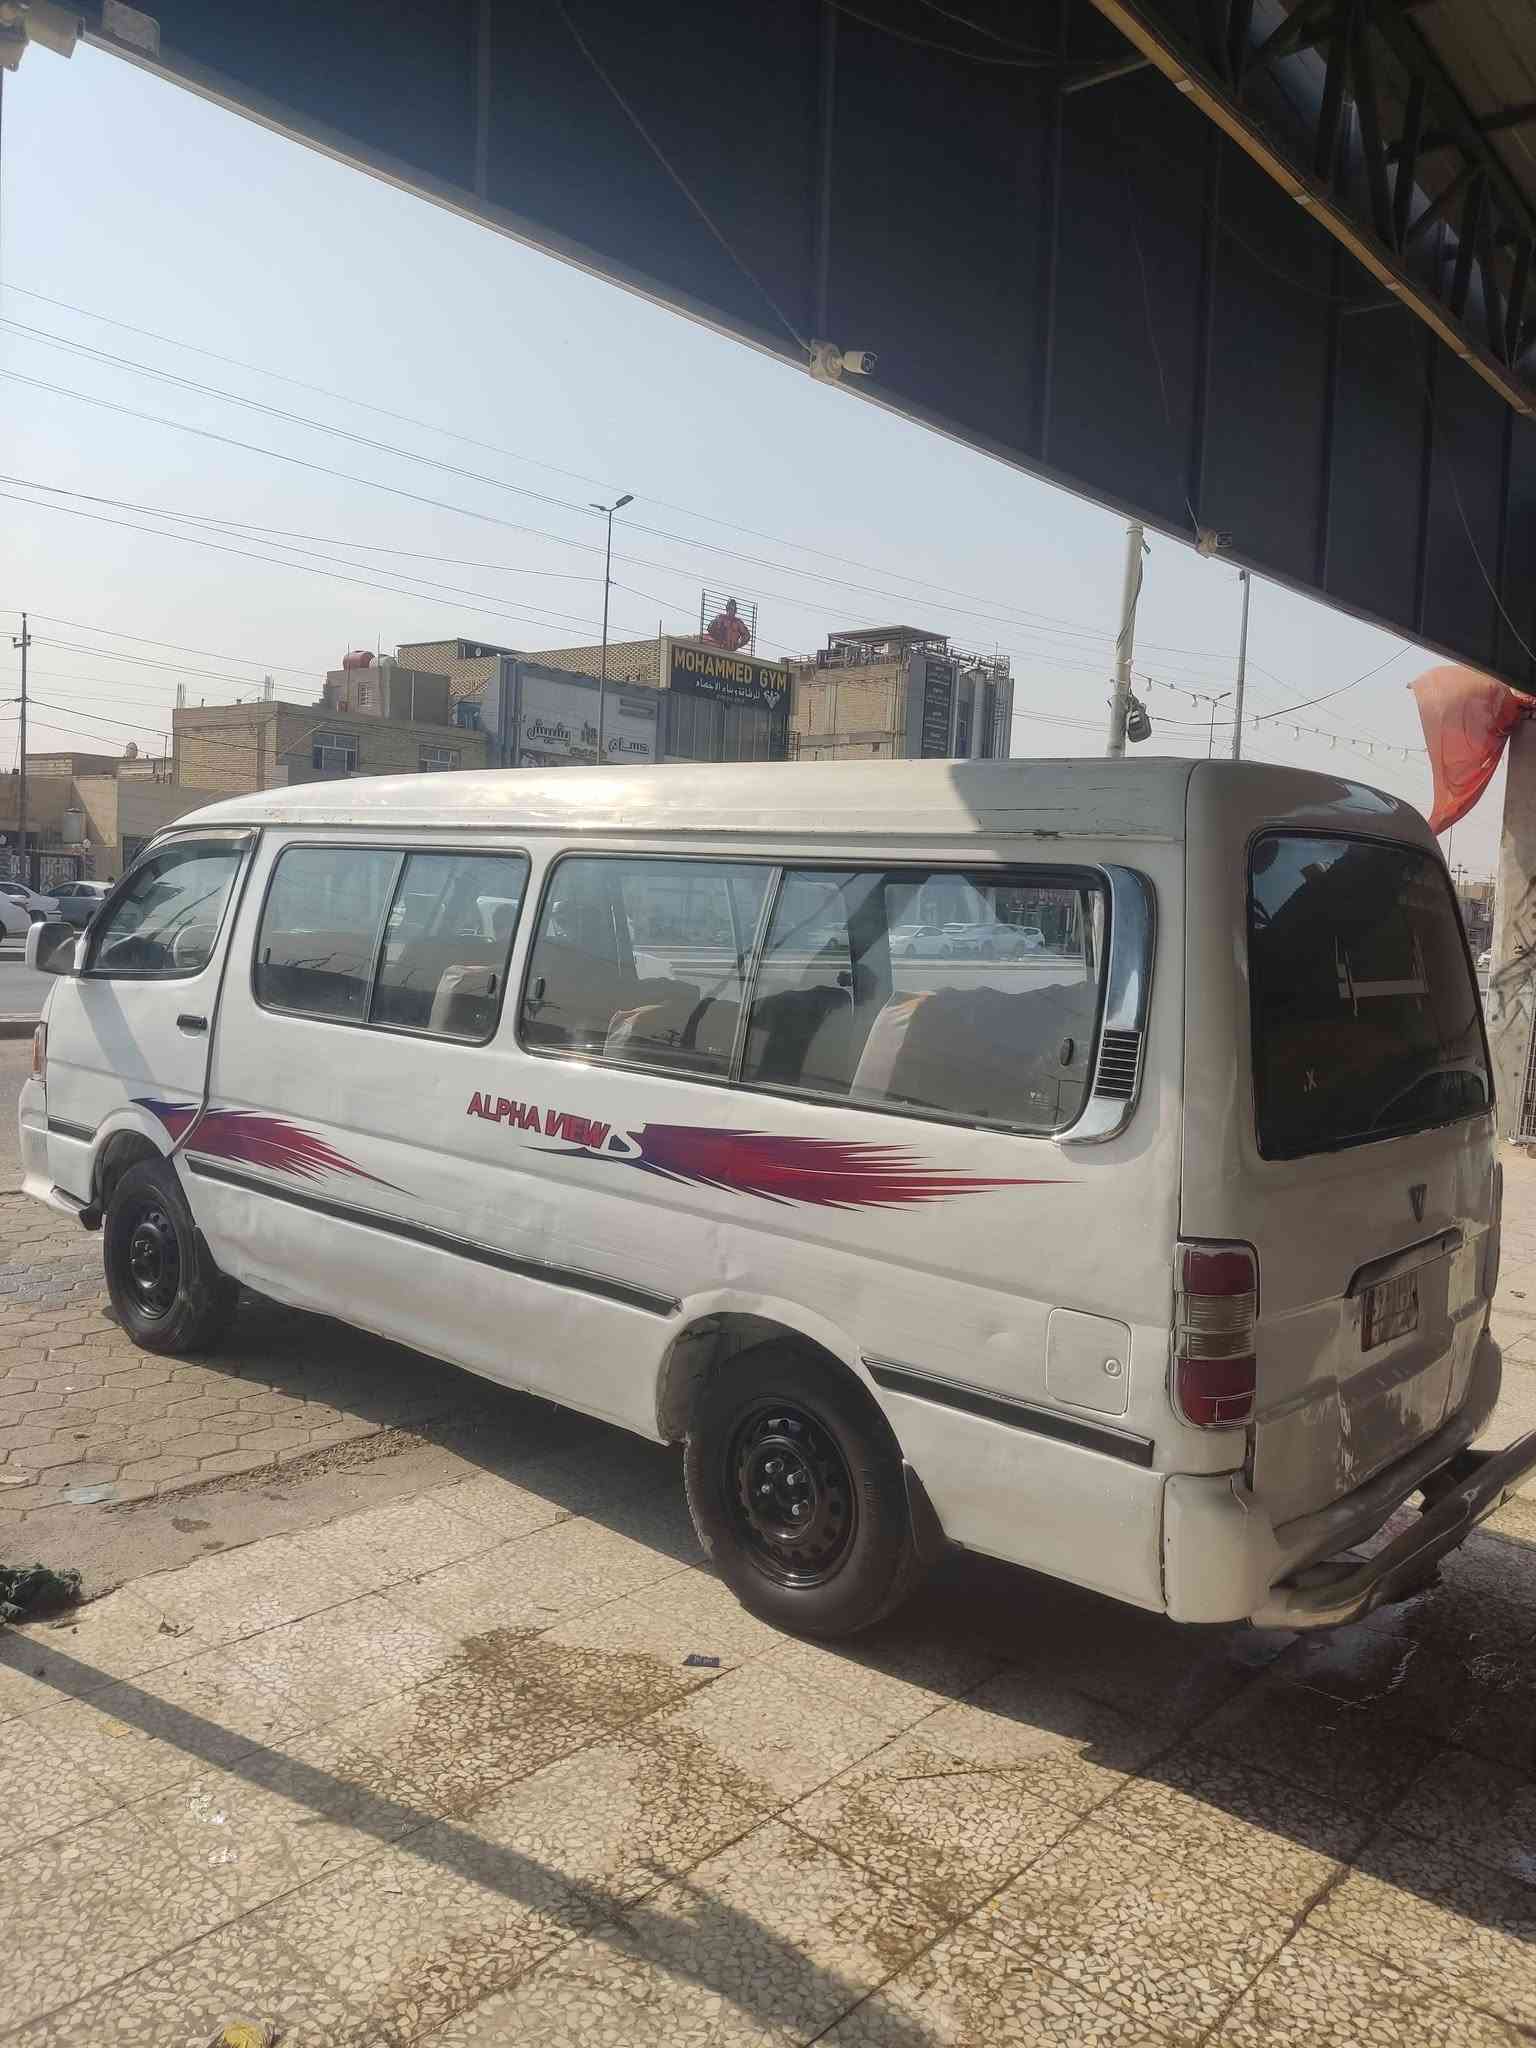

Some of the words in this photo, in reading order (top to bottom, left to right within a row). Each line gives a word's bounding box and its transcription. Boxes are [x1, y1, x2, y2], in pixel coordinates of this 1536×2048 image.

[674, 647, 753, 684] MOHAMMED
[759, 668, 787, 692] GYM
[466, 1090, 542, 1133] ALPHA
[544, 1109, 611, 1150] VIEW
